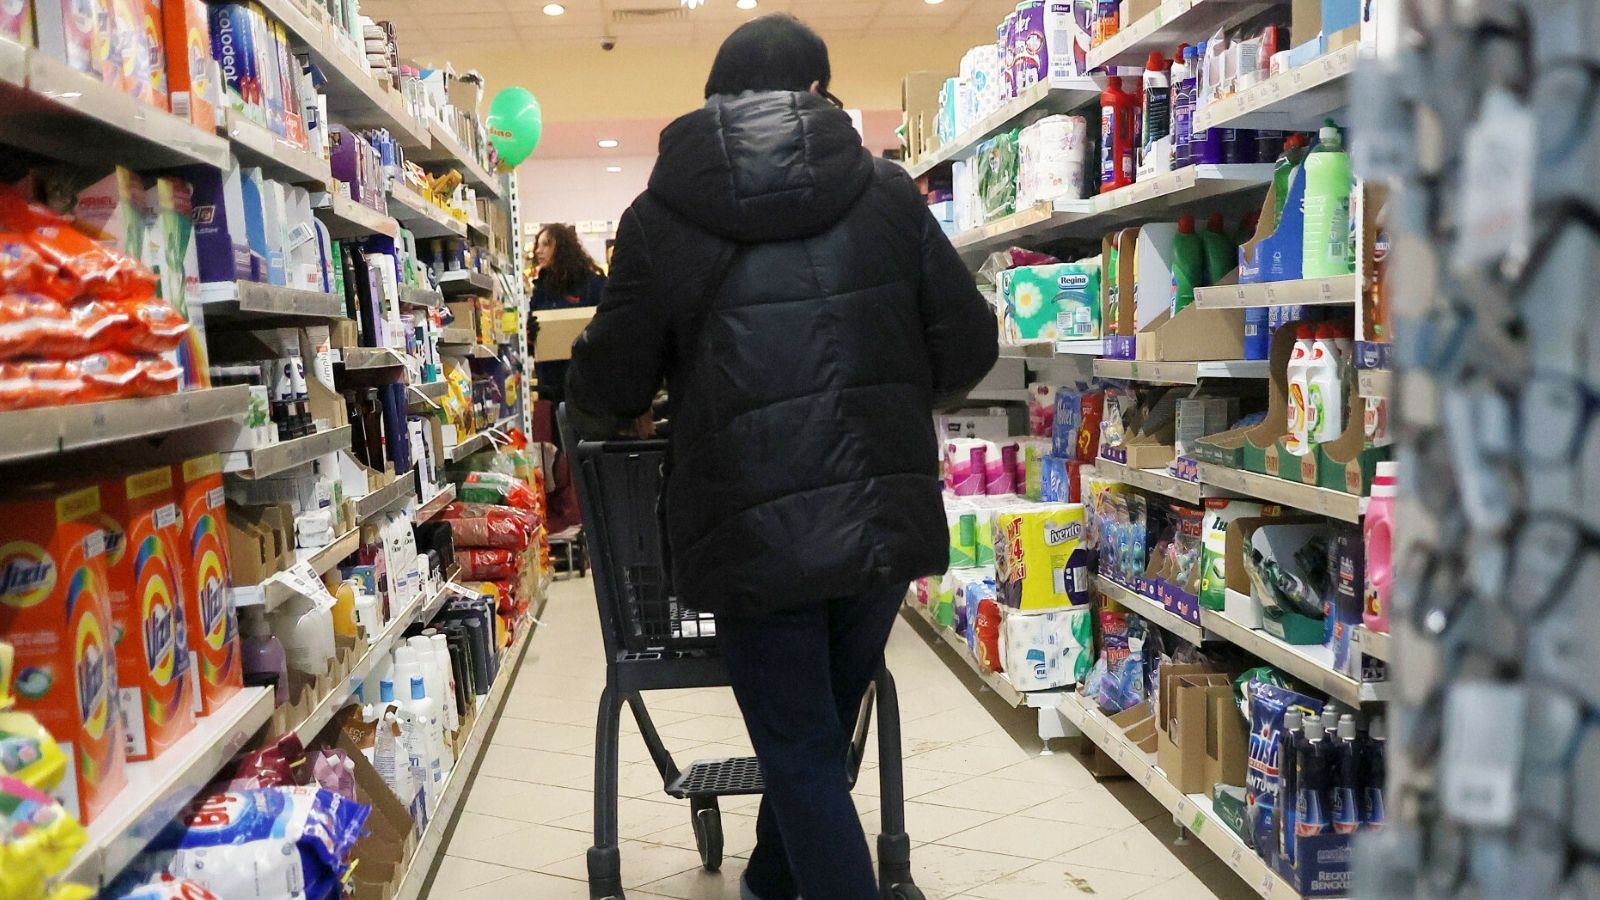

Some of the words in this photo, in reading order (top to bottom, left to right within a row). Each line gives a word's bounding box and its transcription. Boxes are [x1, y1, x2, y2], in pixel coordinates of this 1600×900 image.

[219, 9, 238, 81] colodent
[1060, 276, 1086, 284] Regina
[1051, 522, 1081, 543] ivento
